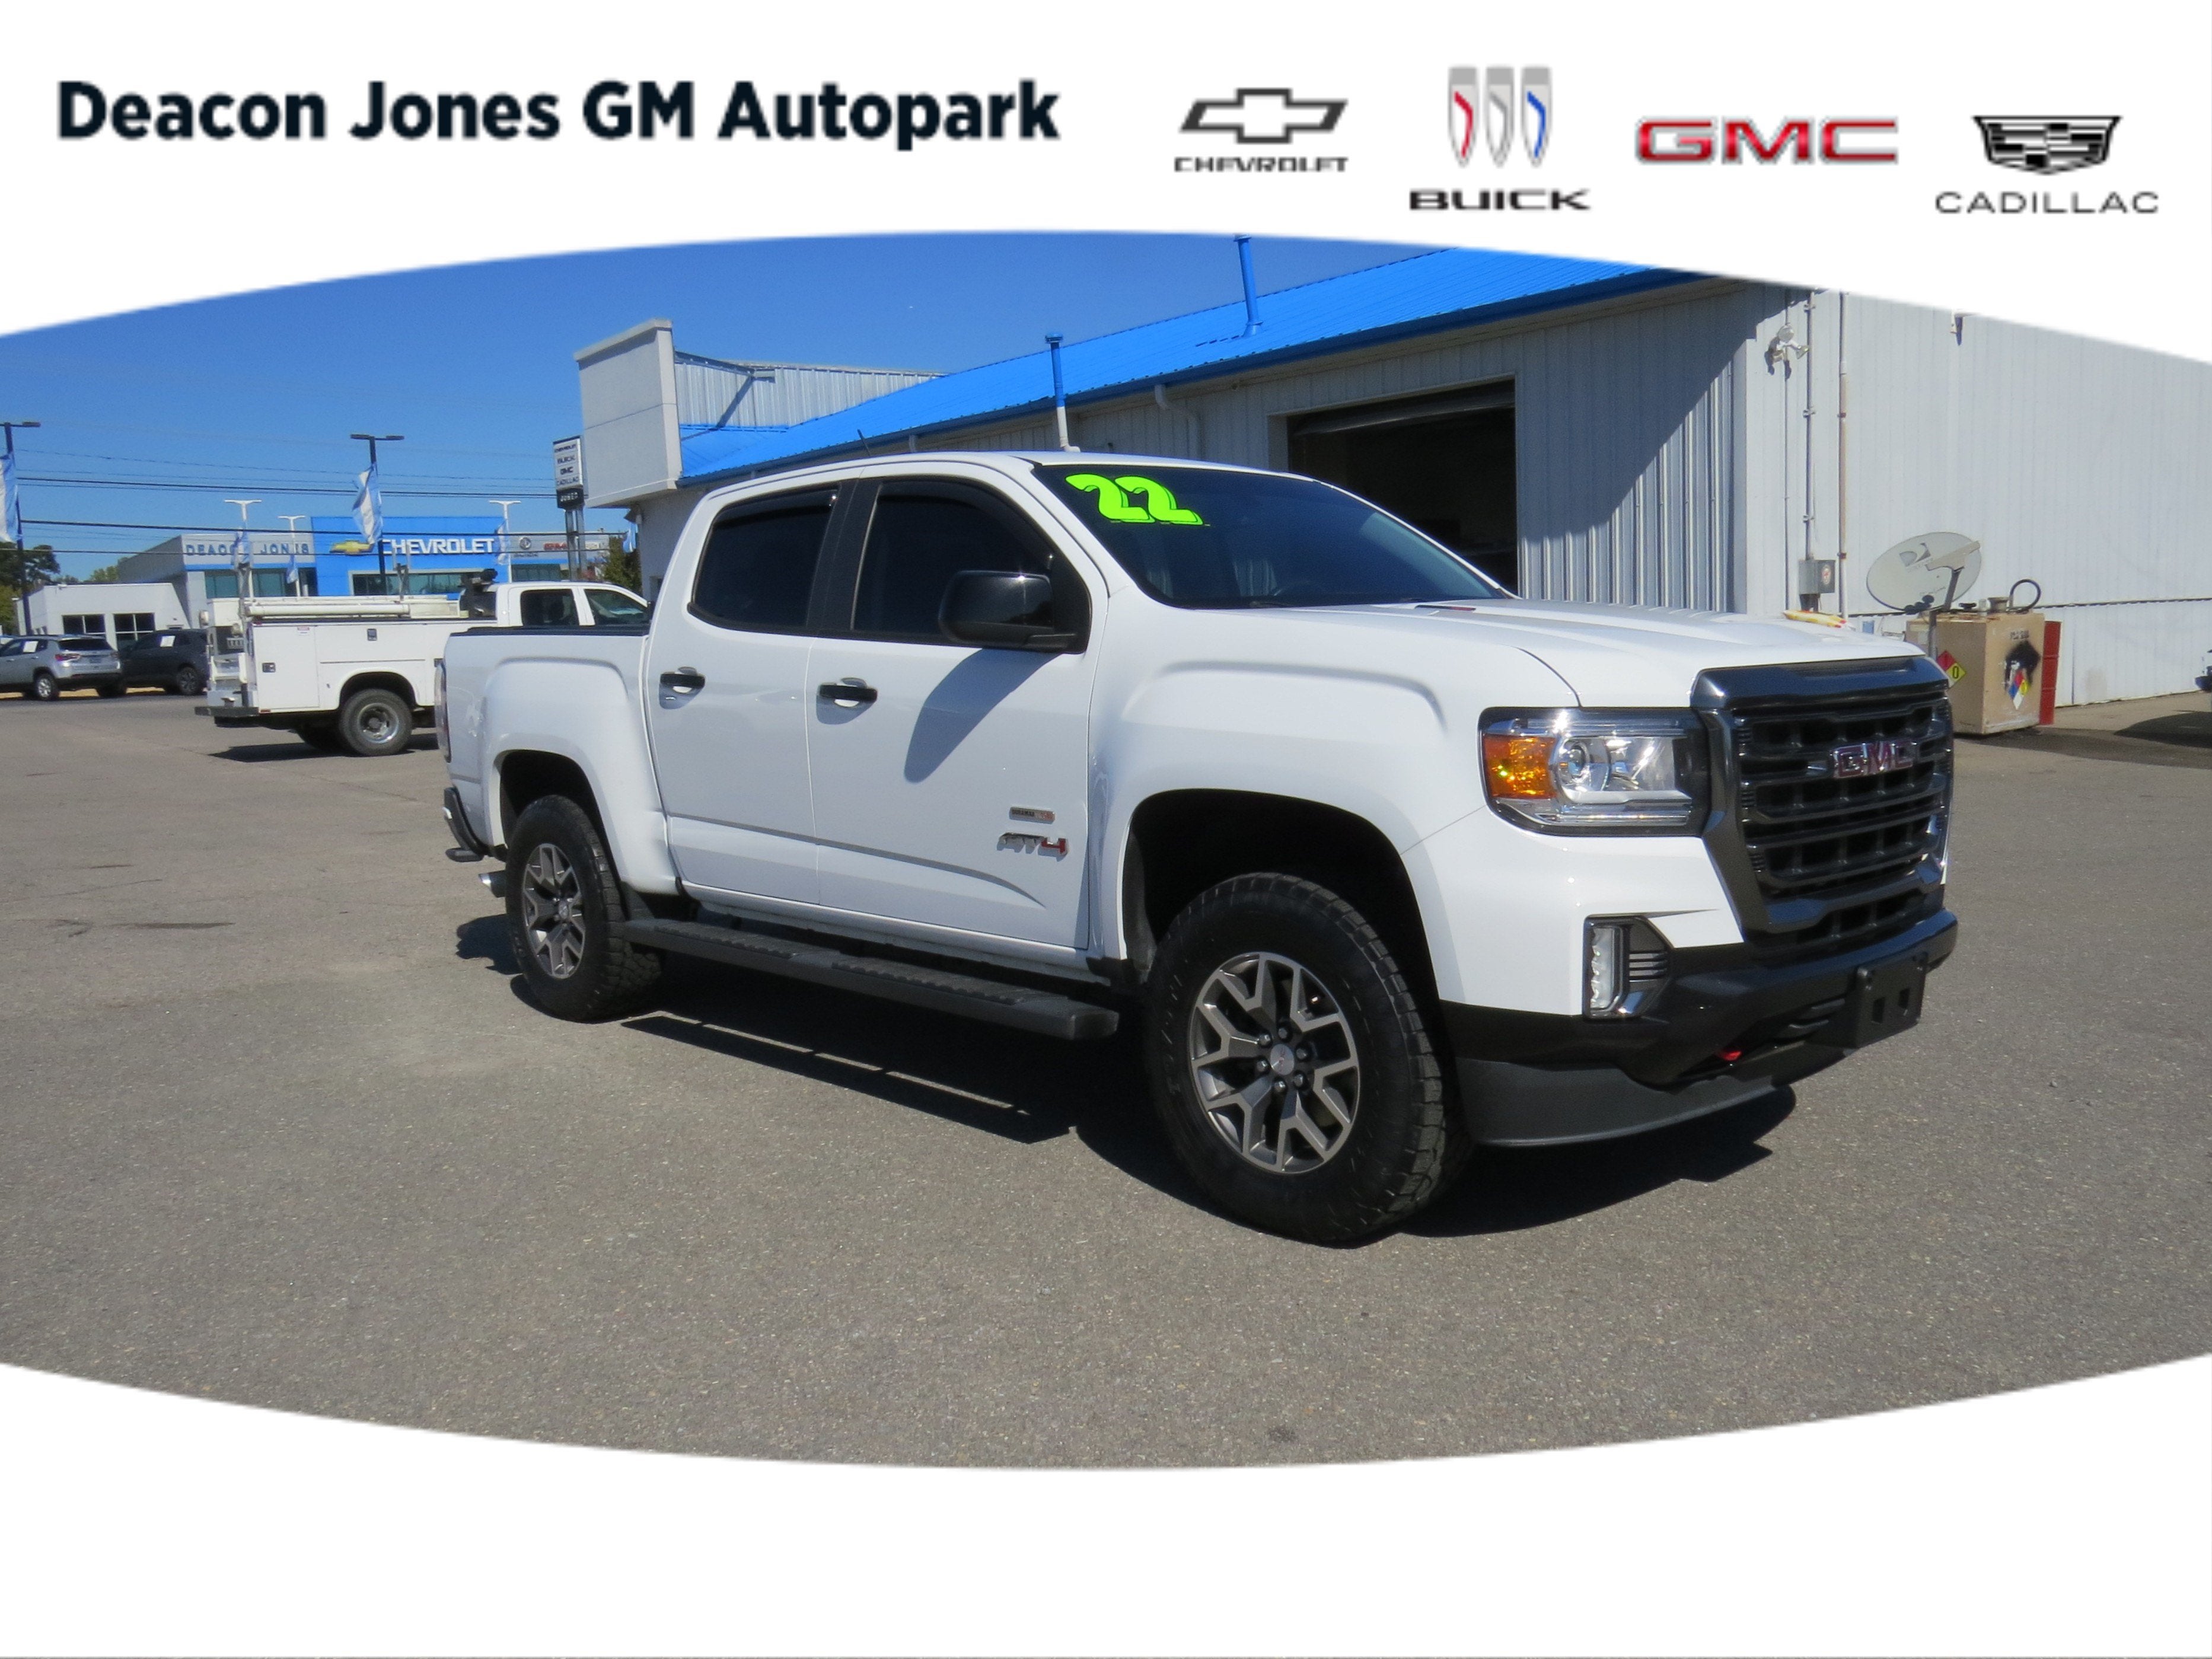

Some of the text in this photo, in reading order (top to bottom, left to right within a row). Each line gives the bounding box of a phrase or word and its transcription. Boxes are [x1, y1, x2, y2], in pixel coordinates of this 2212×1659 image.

[1065, 473, 1204, 525] 22
[186, 544, 237, 556] DEAC
[382, 538, 495, 554] CHEVROLET
[1832, 739, 1915, 779] GMC
